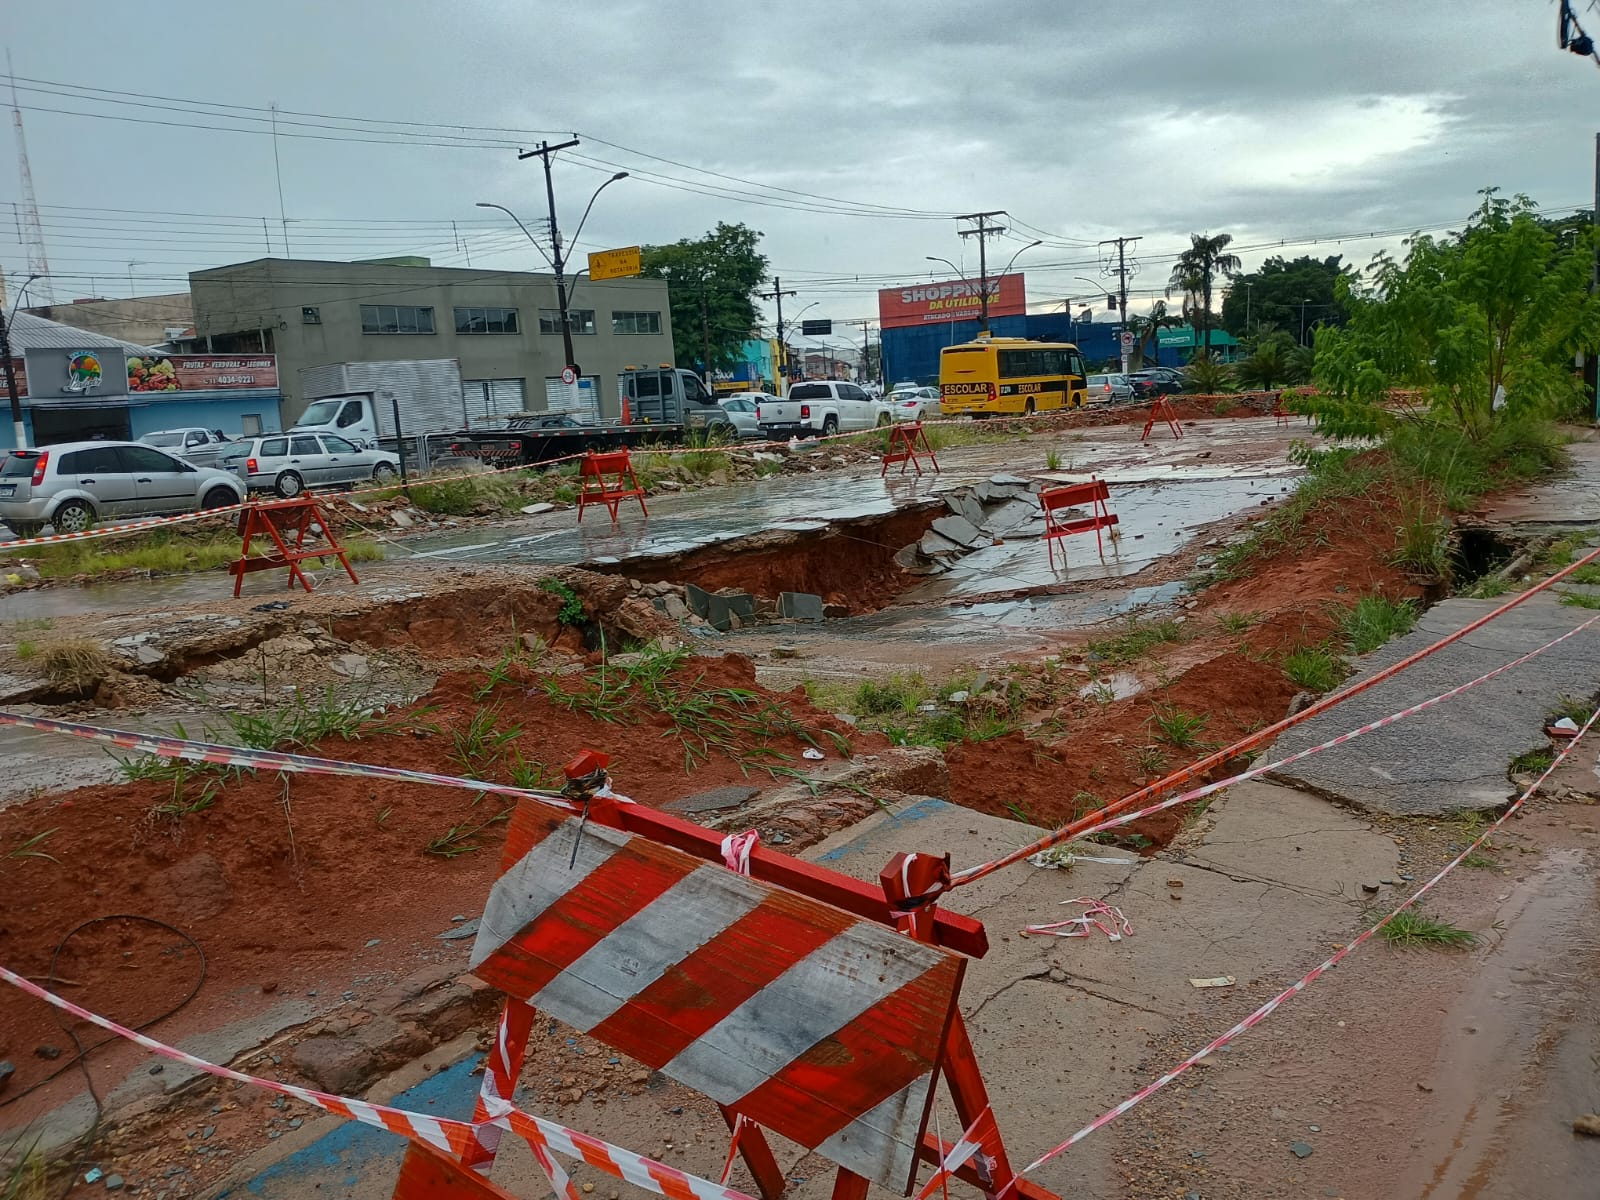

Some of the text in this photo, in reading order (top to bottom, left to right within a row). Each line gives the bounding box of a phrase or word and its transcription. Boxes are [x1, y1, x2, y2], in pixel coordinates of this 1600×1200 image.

[929, 301, 943, 310] DA
[183, 361, 205, 369] FRUTAS
[246, 360, 271, 368] LEGUMES
[944, 383, 988, 394] ESCOLAR
[1018, 383, 1042, 394] ESCOLAR
